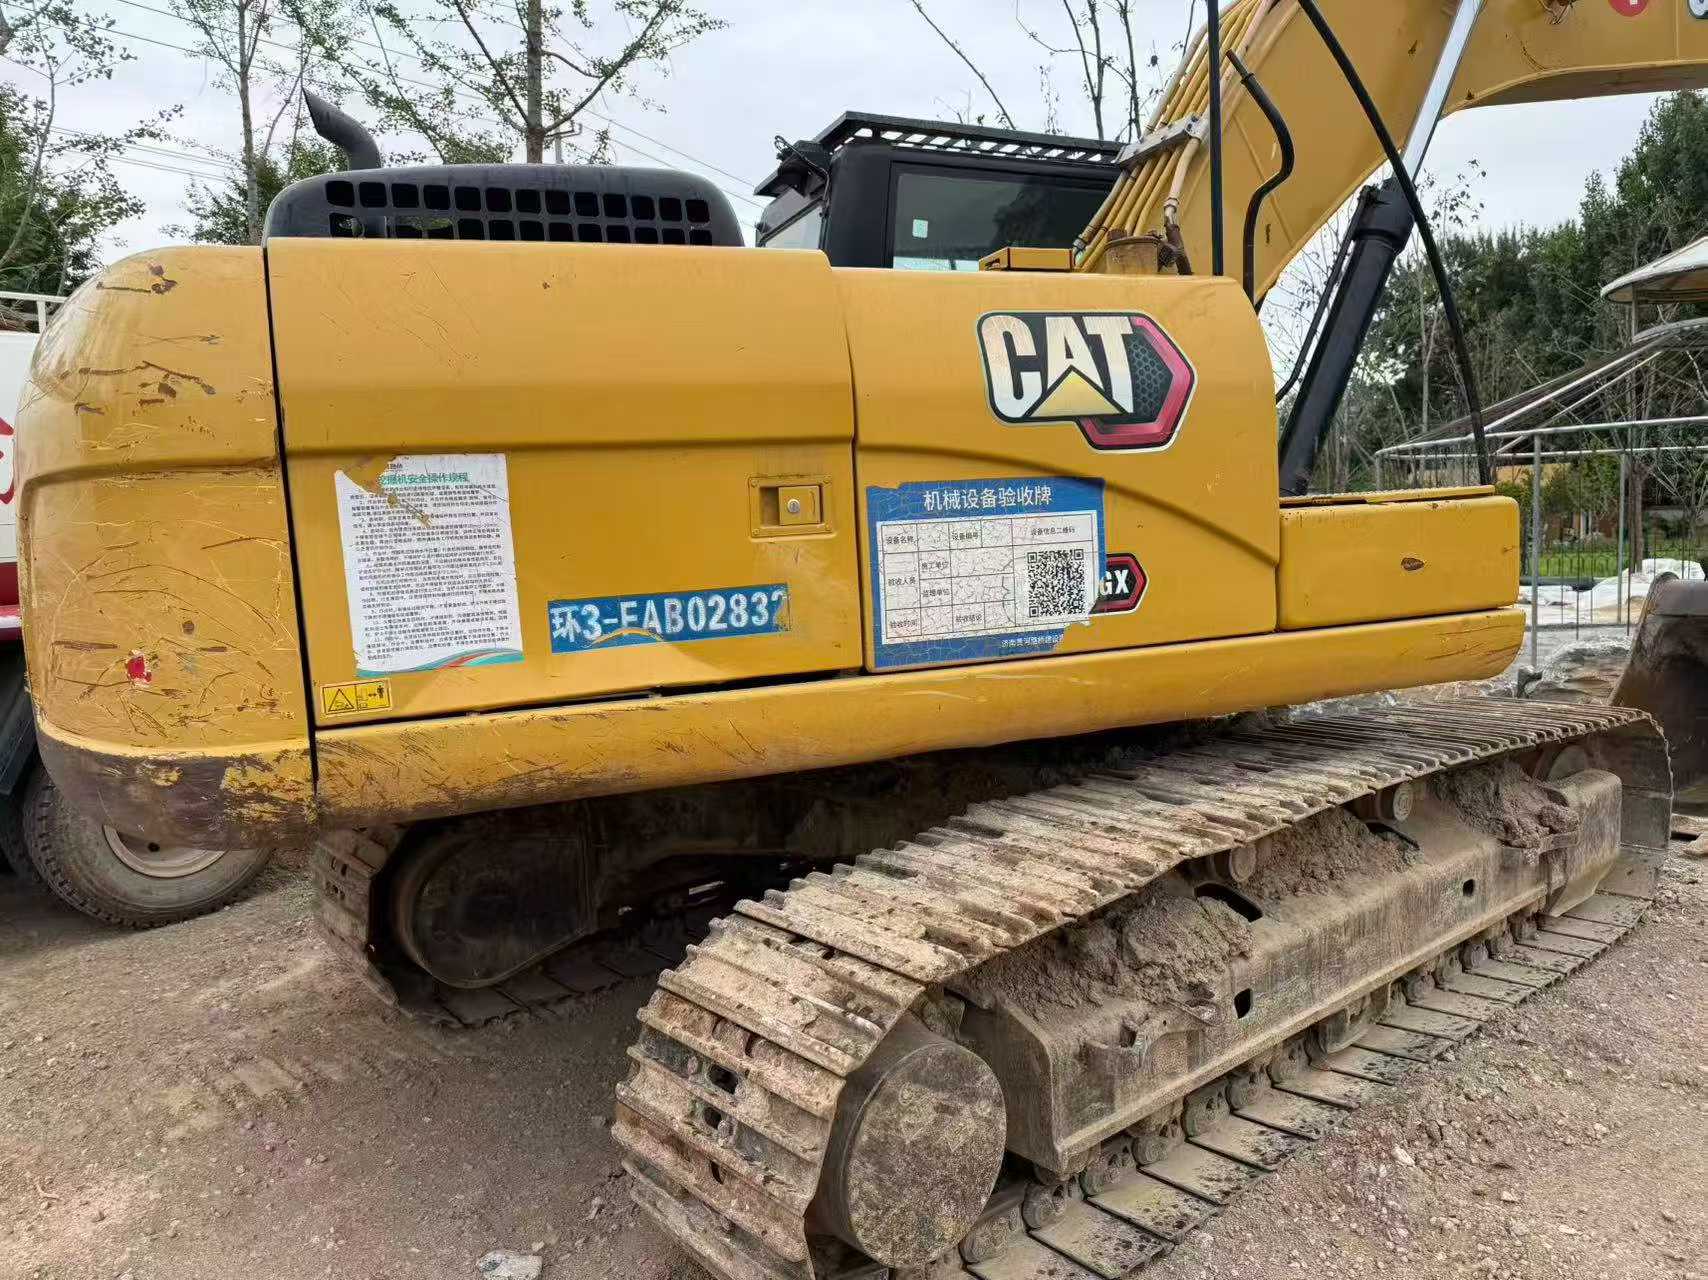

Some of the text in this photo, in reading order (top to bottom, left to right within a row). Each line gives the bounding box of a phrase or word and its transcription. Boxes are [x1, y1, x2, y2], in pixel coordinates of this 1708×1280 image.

[982, 315, 1134, 418] CAT
[923, 486, 1052, 511] 机械设备验收牌
[952, 532, 979, 541] 设备编号
[1031, 526, 1075, 536] 设备信息二维码
[885, 534, 915, 545] 设备名称
[921, 561, 949, 570] 施工单位
[1099, 569, 1130, 595] GX
